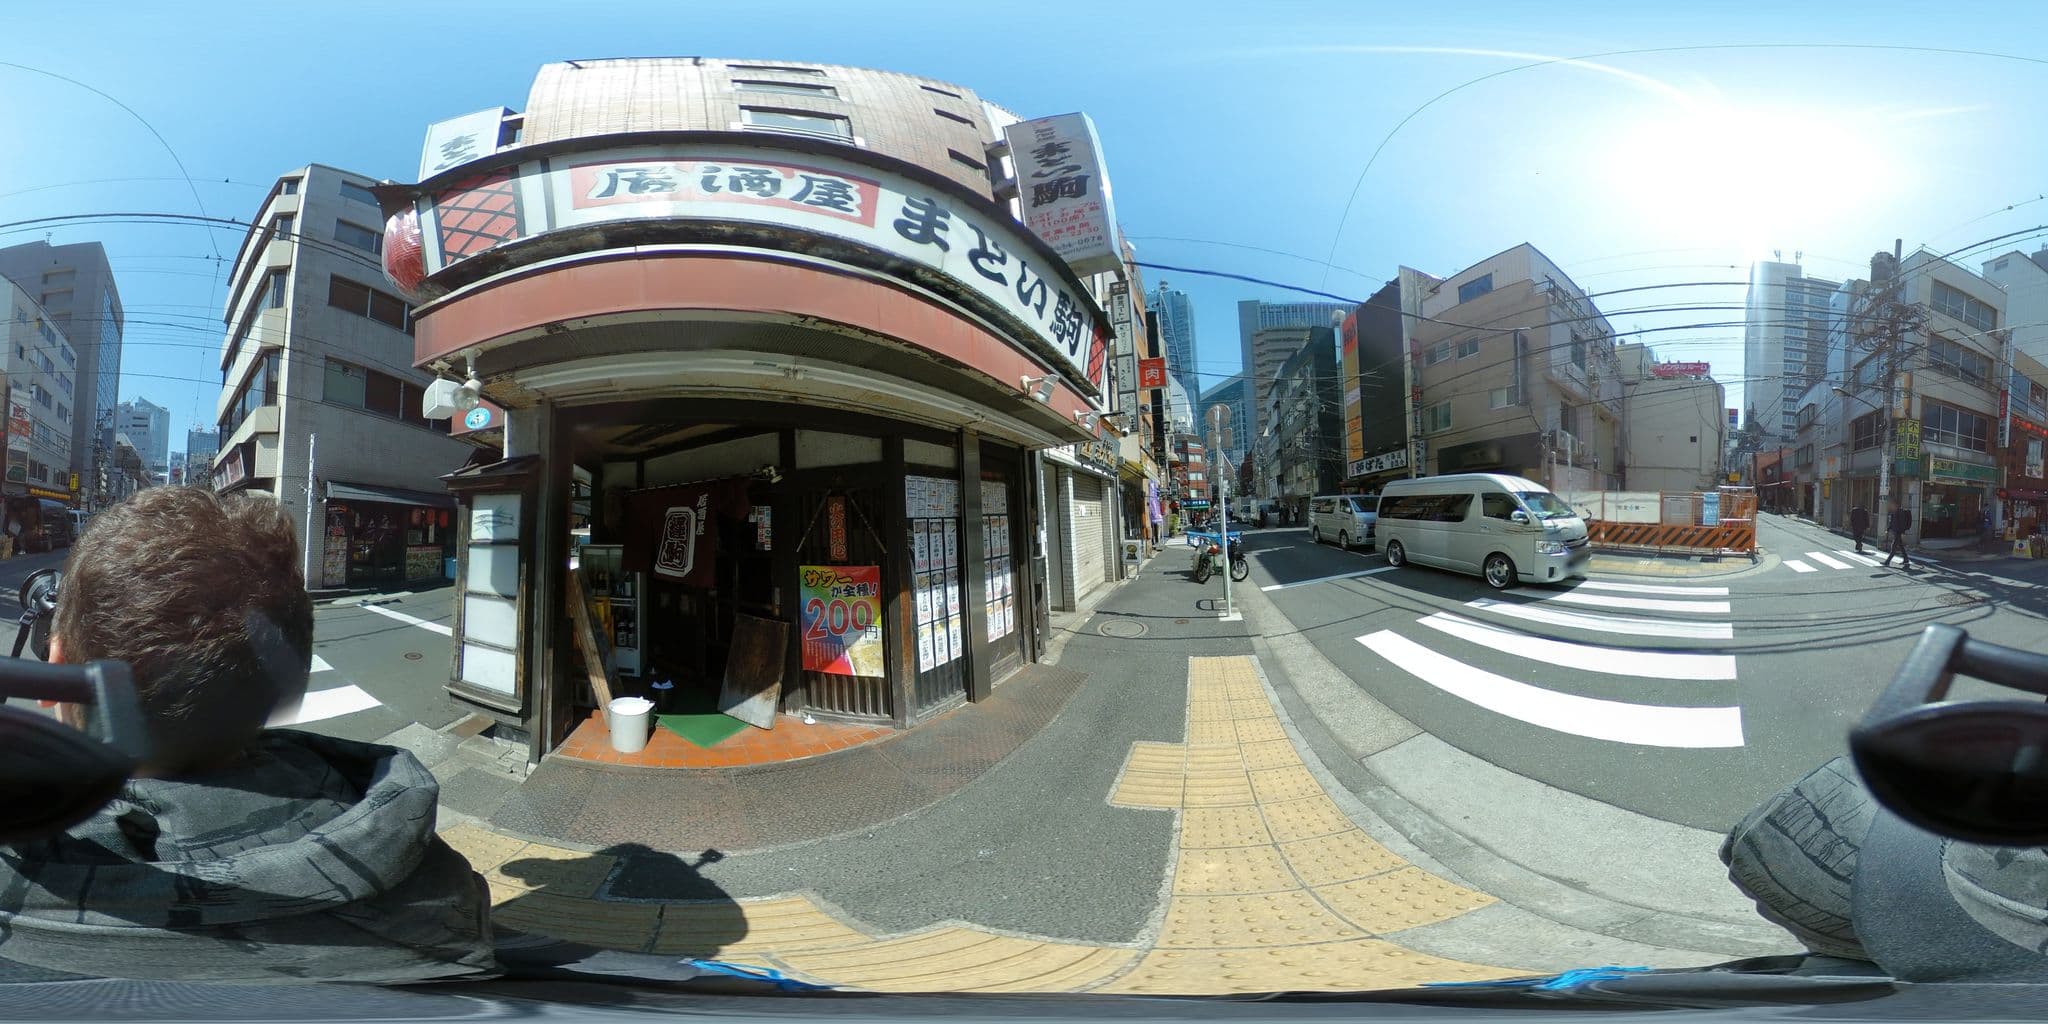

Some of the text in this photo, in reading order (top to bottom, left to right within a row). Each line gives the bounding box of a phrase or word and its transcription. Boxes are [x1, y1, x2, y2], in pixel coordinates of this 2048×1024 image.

[596, 165, 856, 213] 居酒屋
[1145, 367, 1160, 381] 肉
[829, 503, 848, 559] 火の用心
[804, 569, 854, 588] サワー
[806, 598, 873, 640] 200
